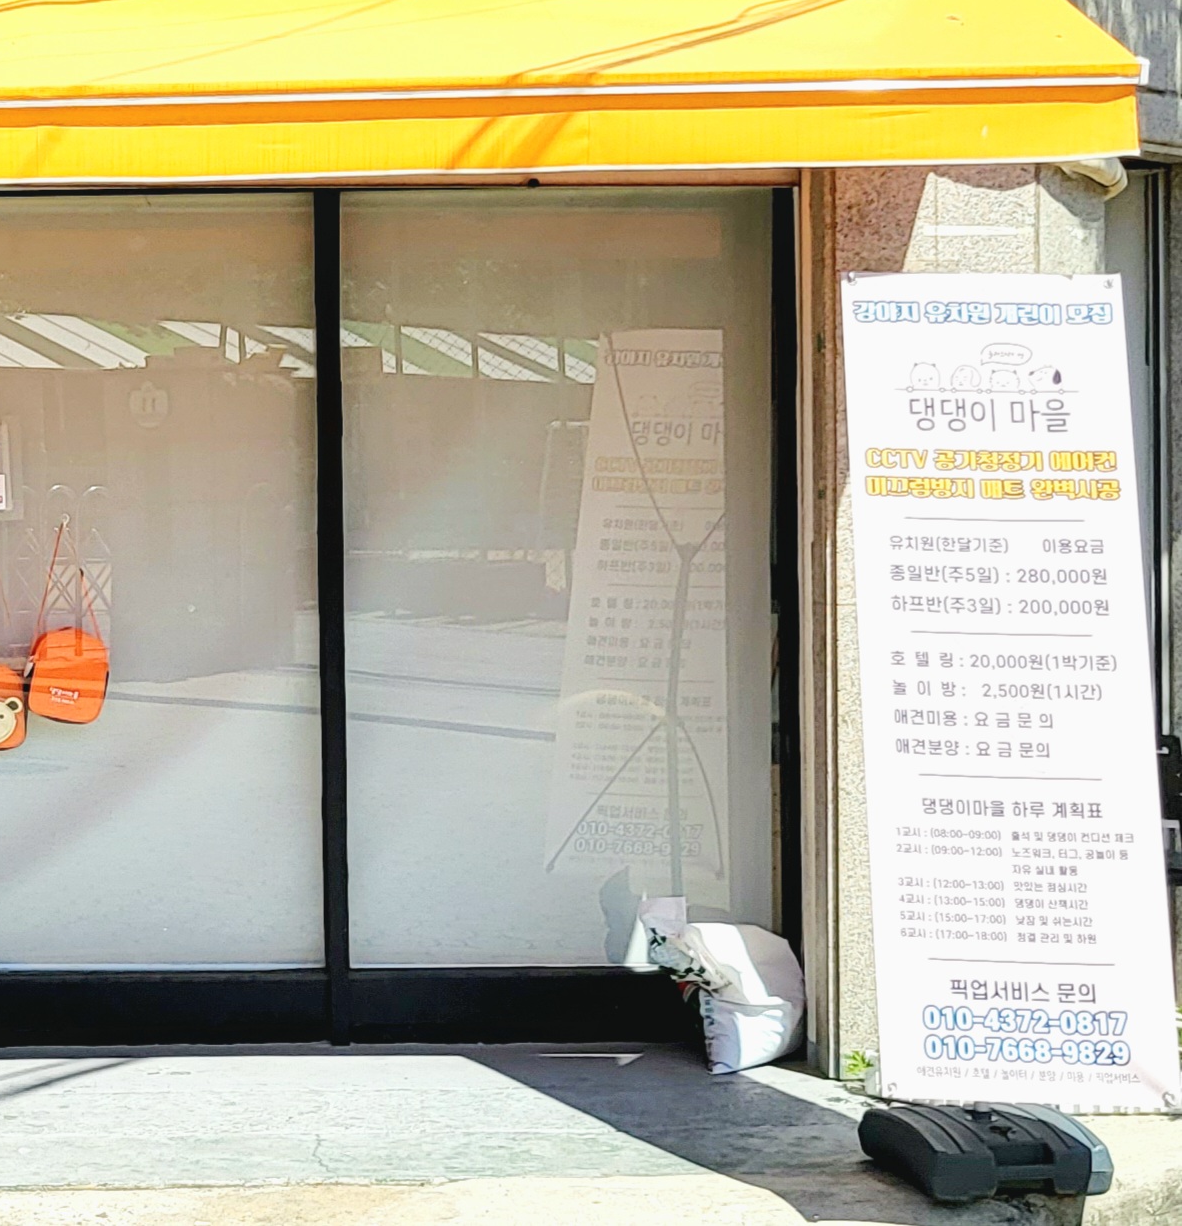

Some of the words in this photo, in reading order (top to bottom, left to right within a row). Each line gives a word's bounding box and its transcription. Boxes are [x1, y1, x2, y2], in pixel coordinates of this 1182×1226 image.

[852, 301, 920, 323] 강아지
[924, 301, 992, 324] 유치원
[994, 303, 1062, 325] 개린이
[1066, 303, 1113, 325] 모집
[909, 398, 995, 432] 댕댕이
[1010, 399, 1071, 433] 마을
[865, 448, 928, 469] CCTV
[933, 449, 1043, 471] 공기청정기
[1049, 450, 1117, 472] 에어컨
[865, 476, 975, 499] 미끄럼방지
[980, 478, 1026, 499] 매트
[1030, 479, 1121, 501] 완벽시공
[889, 535, 1009, 554] 유치원(한달기준)
[1043, 538, 1105, 555] 이용요금
[889, 564, 999, 584] 종일반(주5일)
[1017, 568, 1108, 585] 280,000원
[891, 595, 1001, 615] 하프반(주3일)
[1019, 600, 1110, 616] 200,000원
[970, 653, 1118, 672] 20,000원(1박기준)
[982, 682, 1102, 701] 2,500원(1시간)
[894, 708, 957, 726] 애견미용
[896, 738, 960, 756] 애견분양
[922, 798, 1005, 817] 댕댕이마을
[1012, 801, 1045, 819] 하루
[1052, 802, 1104, 819] 계획표
[949, 979, 1050, 1003] 픽업서비스
[1057, 983, 1097, 1004] 문의
[922, 1005, 1128, 1036] 010-4372-0817
[924, 1034, 1131, 1066] 010-7668-9829
